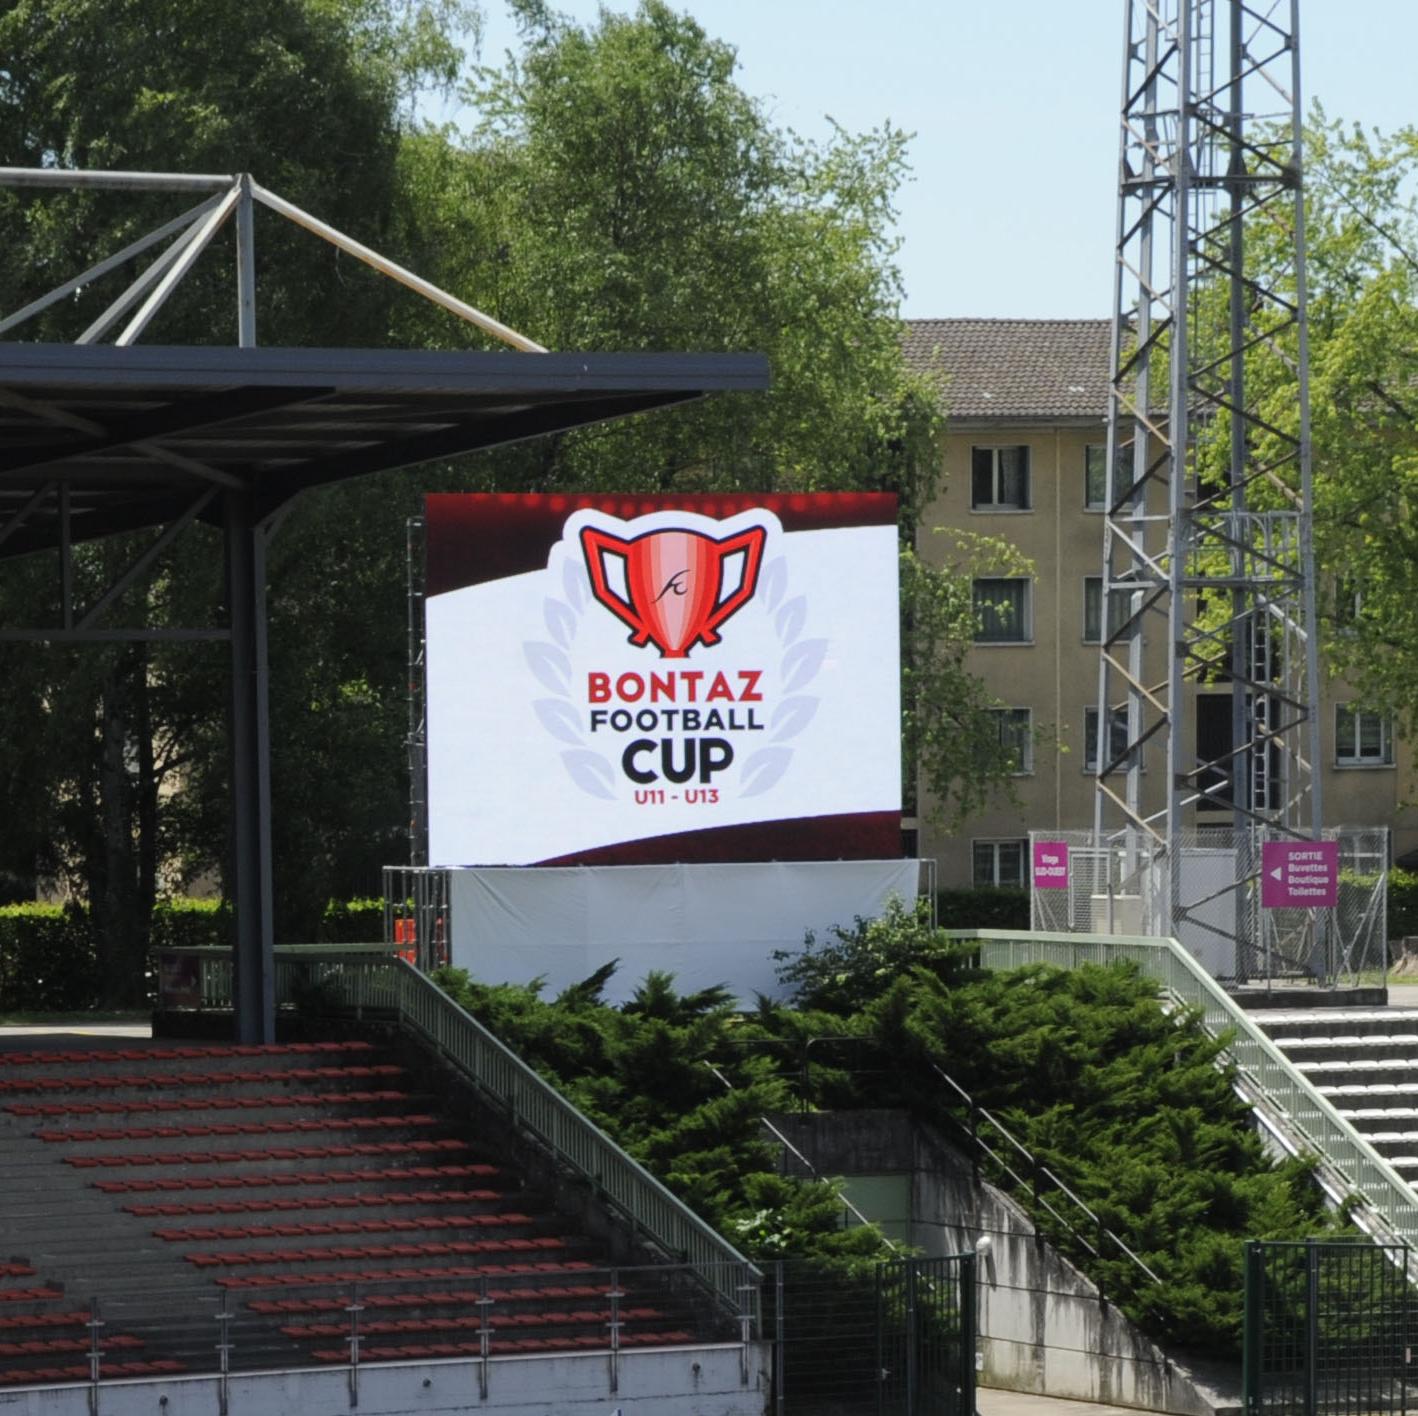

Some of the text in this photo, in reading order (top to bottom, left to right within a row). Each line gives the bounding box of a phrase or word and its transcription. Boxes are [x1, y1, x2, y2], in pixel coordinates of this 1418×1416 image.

[587, 670, 764, 703] BONTAZ
[590, 708, 764, 732] FOOTBALL
[622, 738, 734, 784] CUP
[634, 790, 666, 805] U11
[684, 790, 719, 805] U13
[1288, 851, 1323, 861] SORTIE
[1288, 863, 1328, 873] Buvettes
[1288, 875, 1329, 885] Boutique
